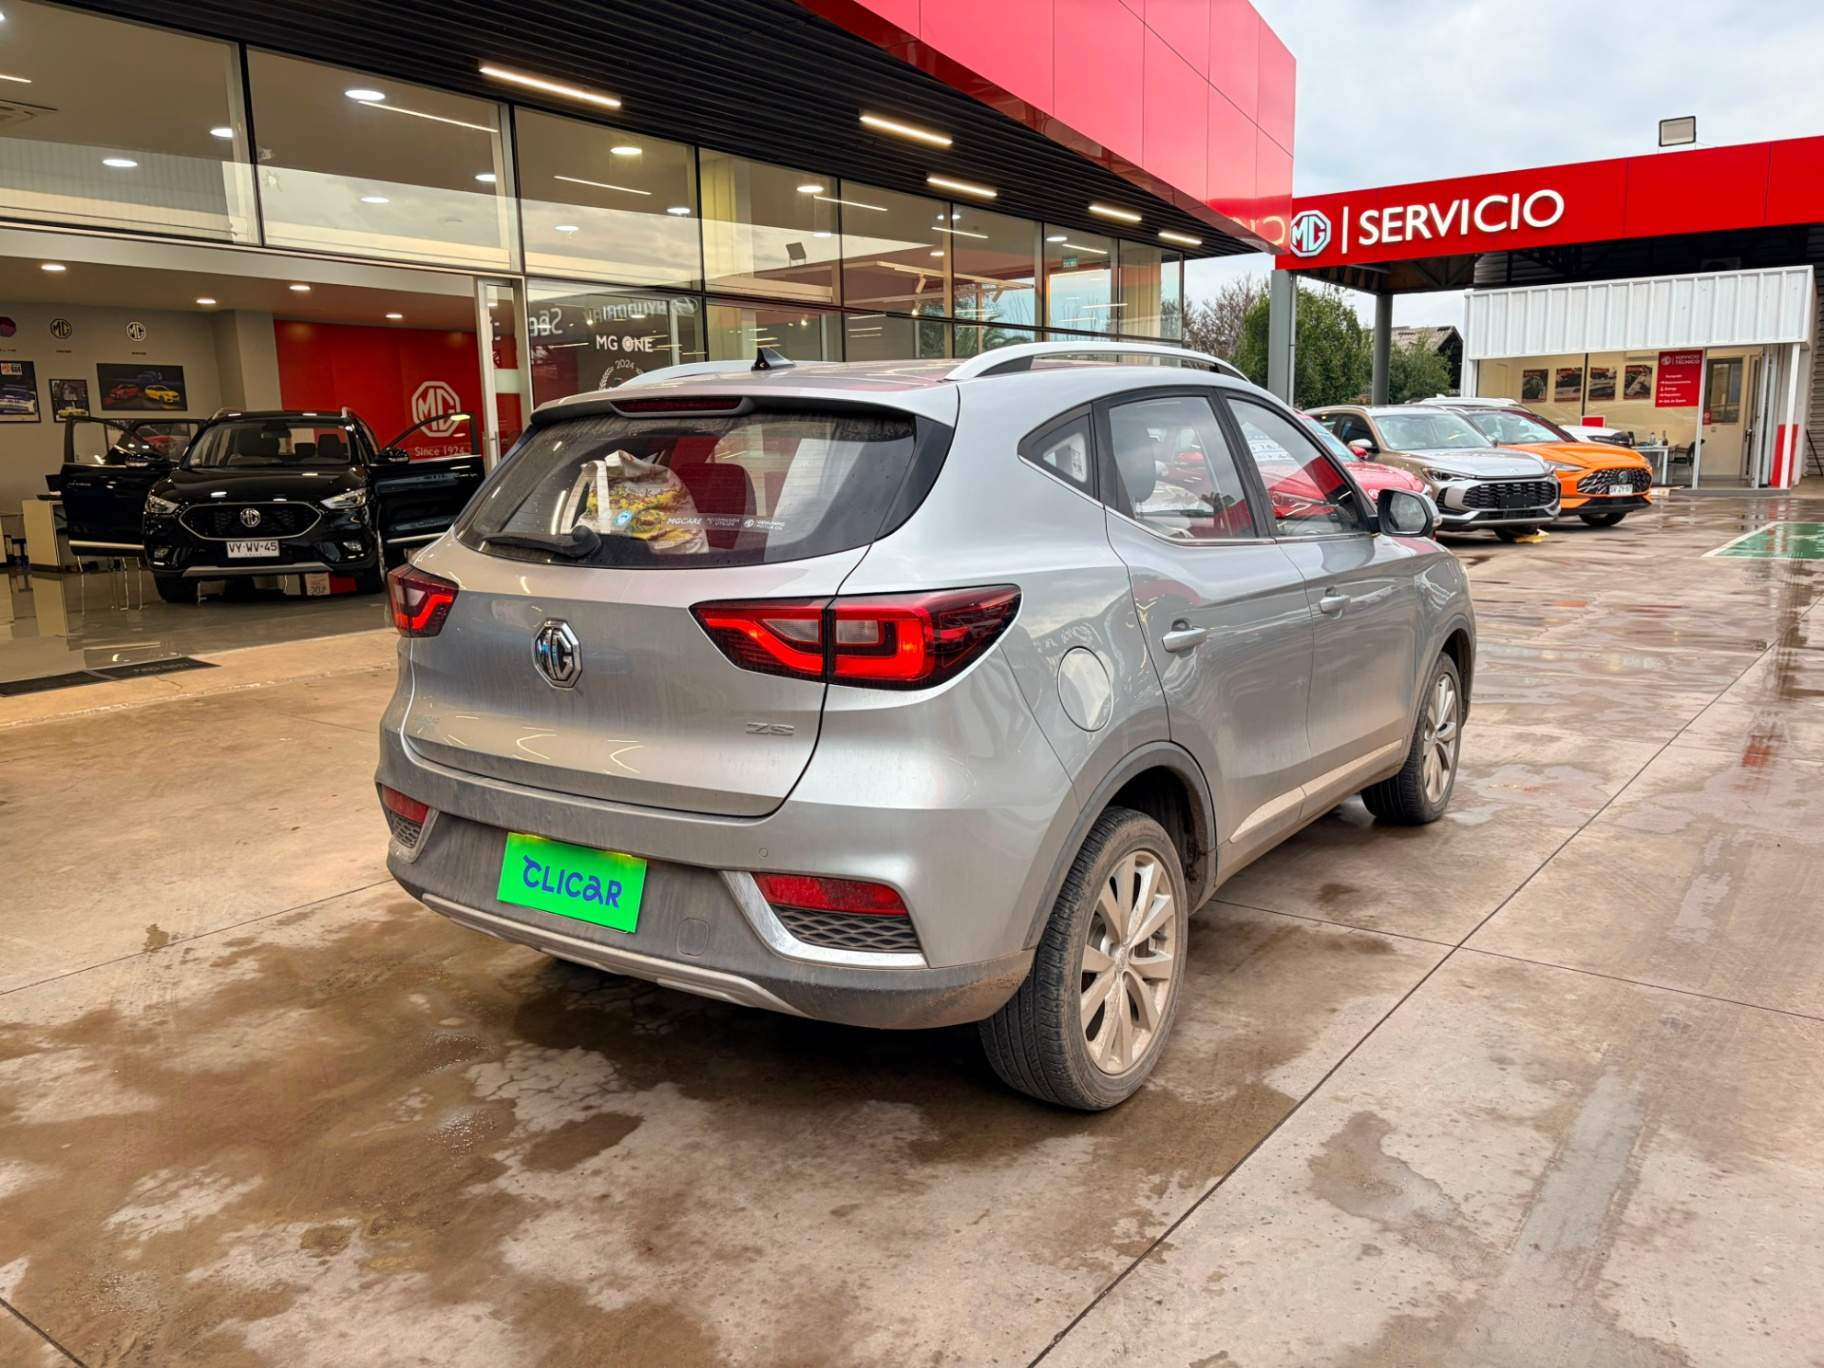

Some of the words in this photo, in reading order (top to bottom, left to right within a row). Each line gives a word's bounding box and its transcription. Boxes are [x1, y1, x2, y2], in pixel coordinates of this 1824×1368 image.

[1291, 212, 1329, 255] MG
[1358, 189, 1565, 246] SERVICIO
[596, 334, 618, 351] MG
[622, 335, 655, 352] ONE
[615, 358, 635, 369] 2024
[415, 385, 458, 433] MG
[415, 446, 440, 457] Since
[535, 621, 579, 684] MG
[745, 722, 794, 737] ZS
